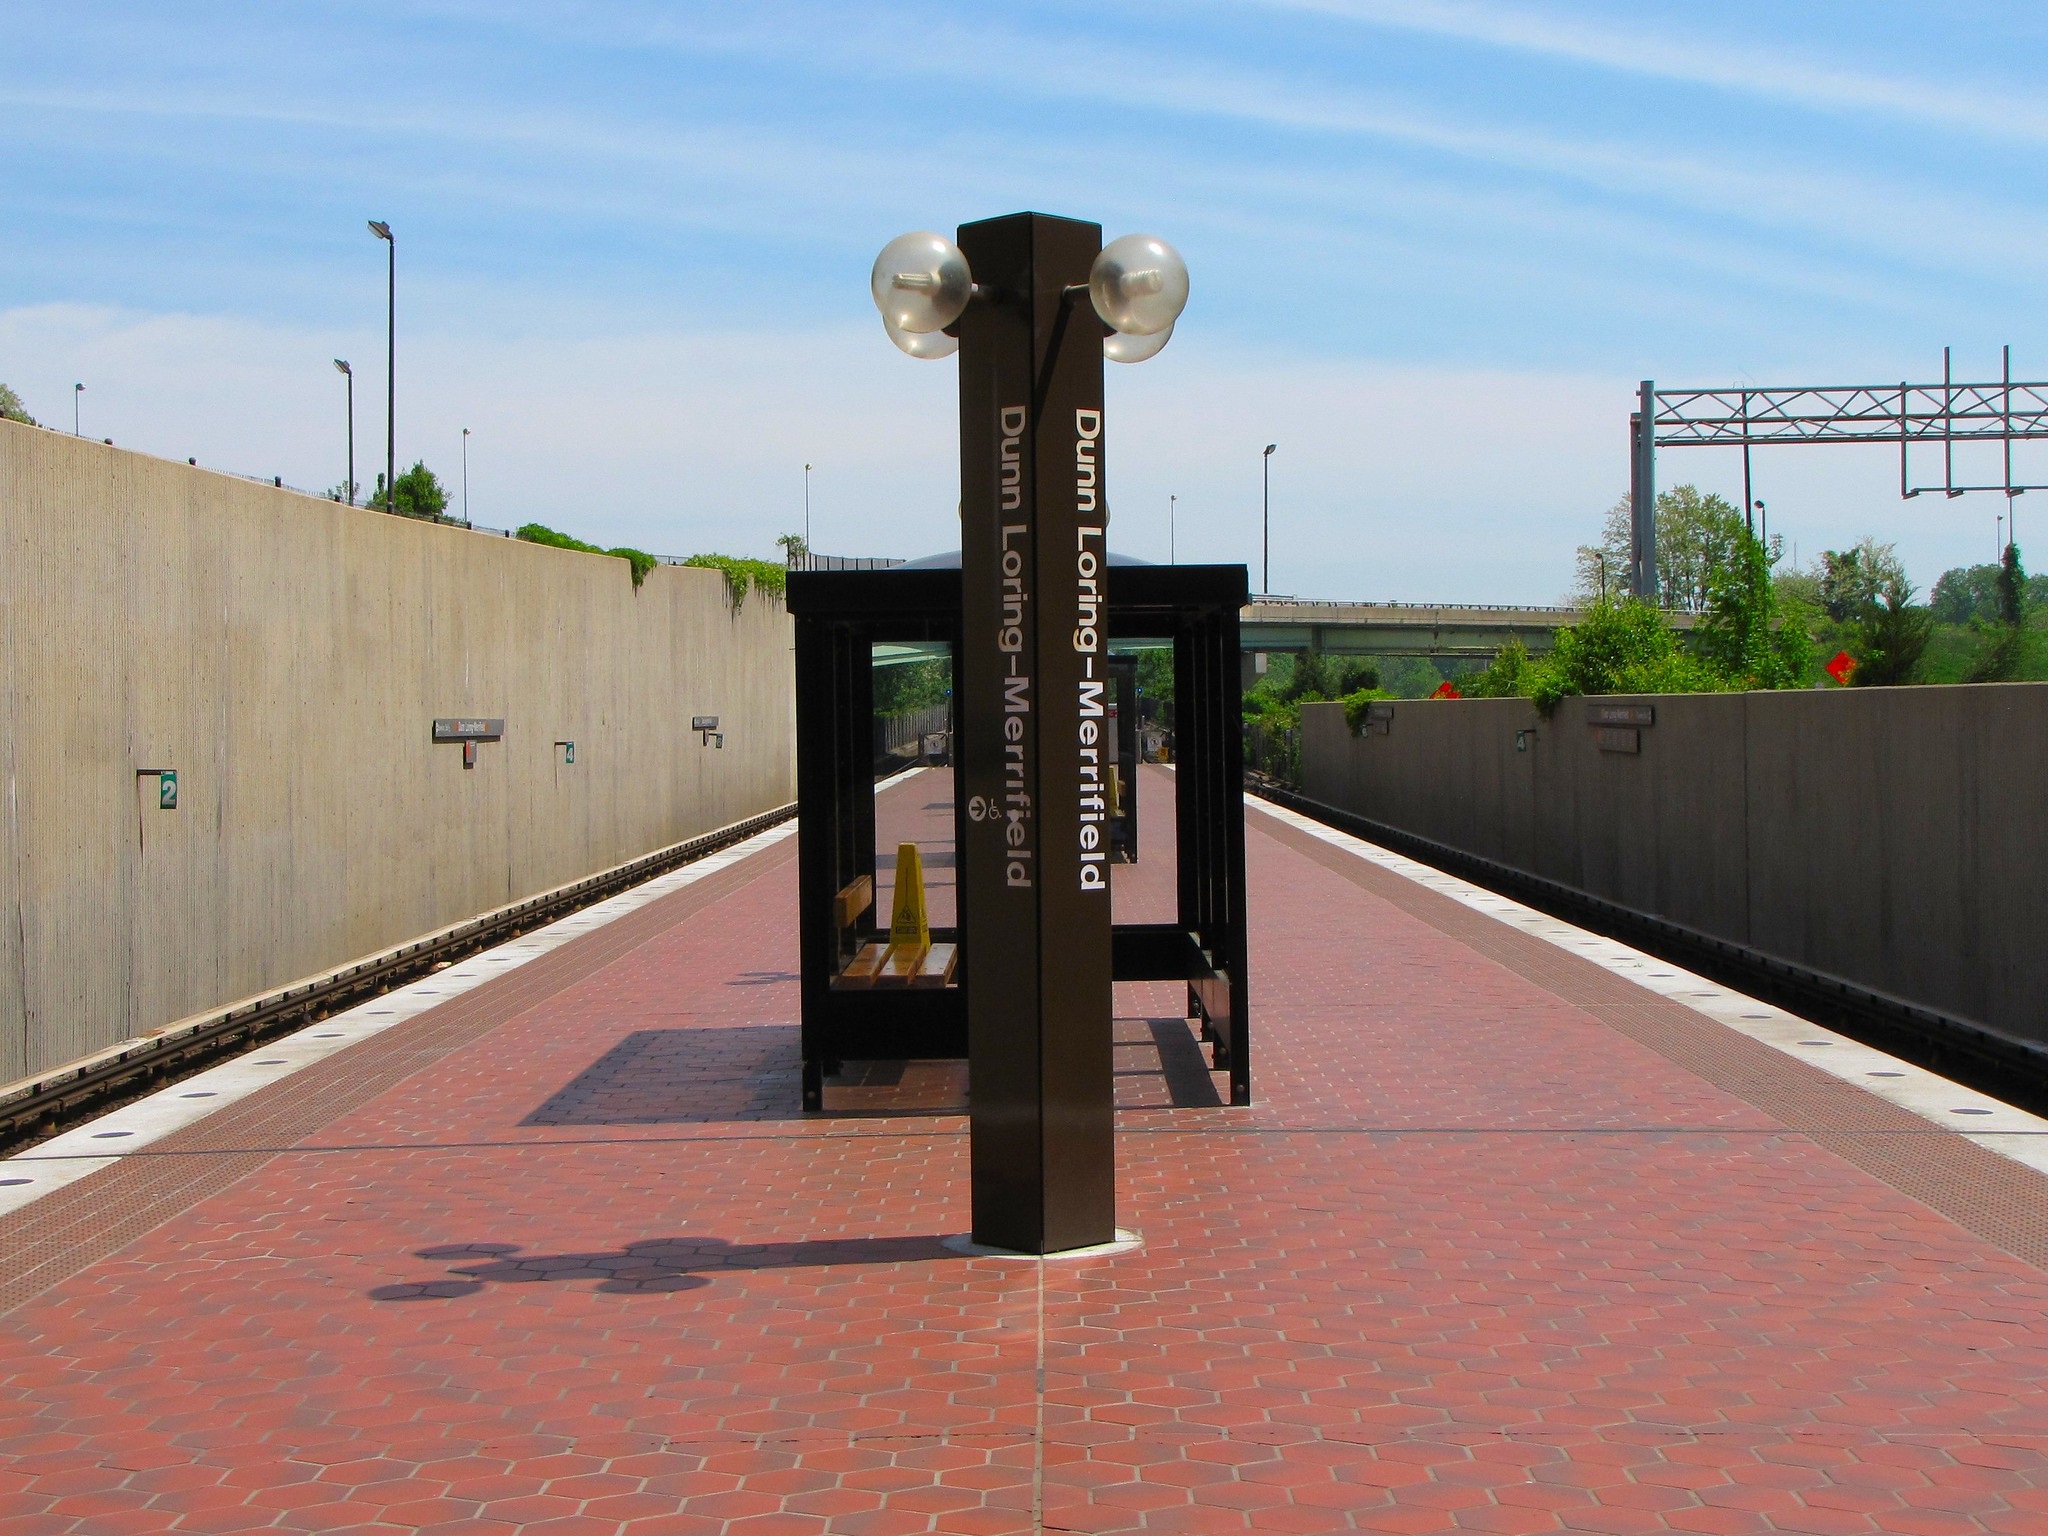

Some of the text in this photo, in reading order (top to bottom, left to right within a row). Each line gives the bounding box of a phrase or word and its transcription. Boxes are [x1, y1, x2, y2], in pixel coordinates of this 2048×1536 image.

[1001, 405, 1026, 510] Dunn
[1075, 408, 1101, 511] Dunn
[162, 780, 176, 805] 2
